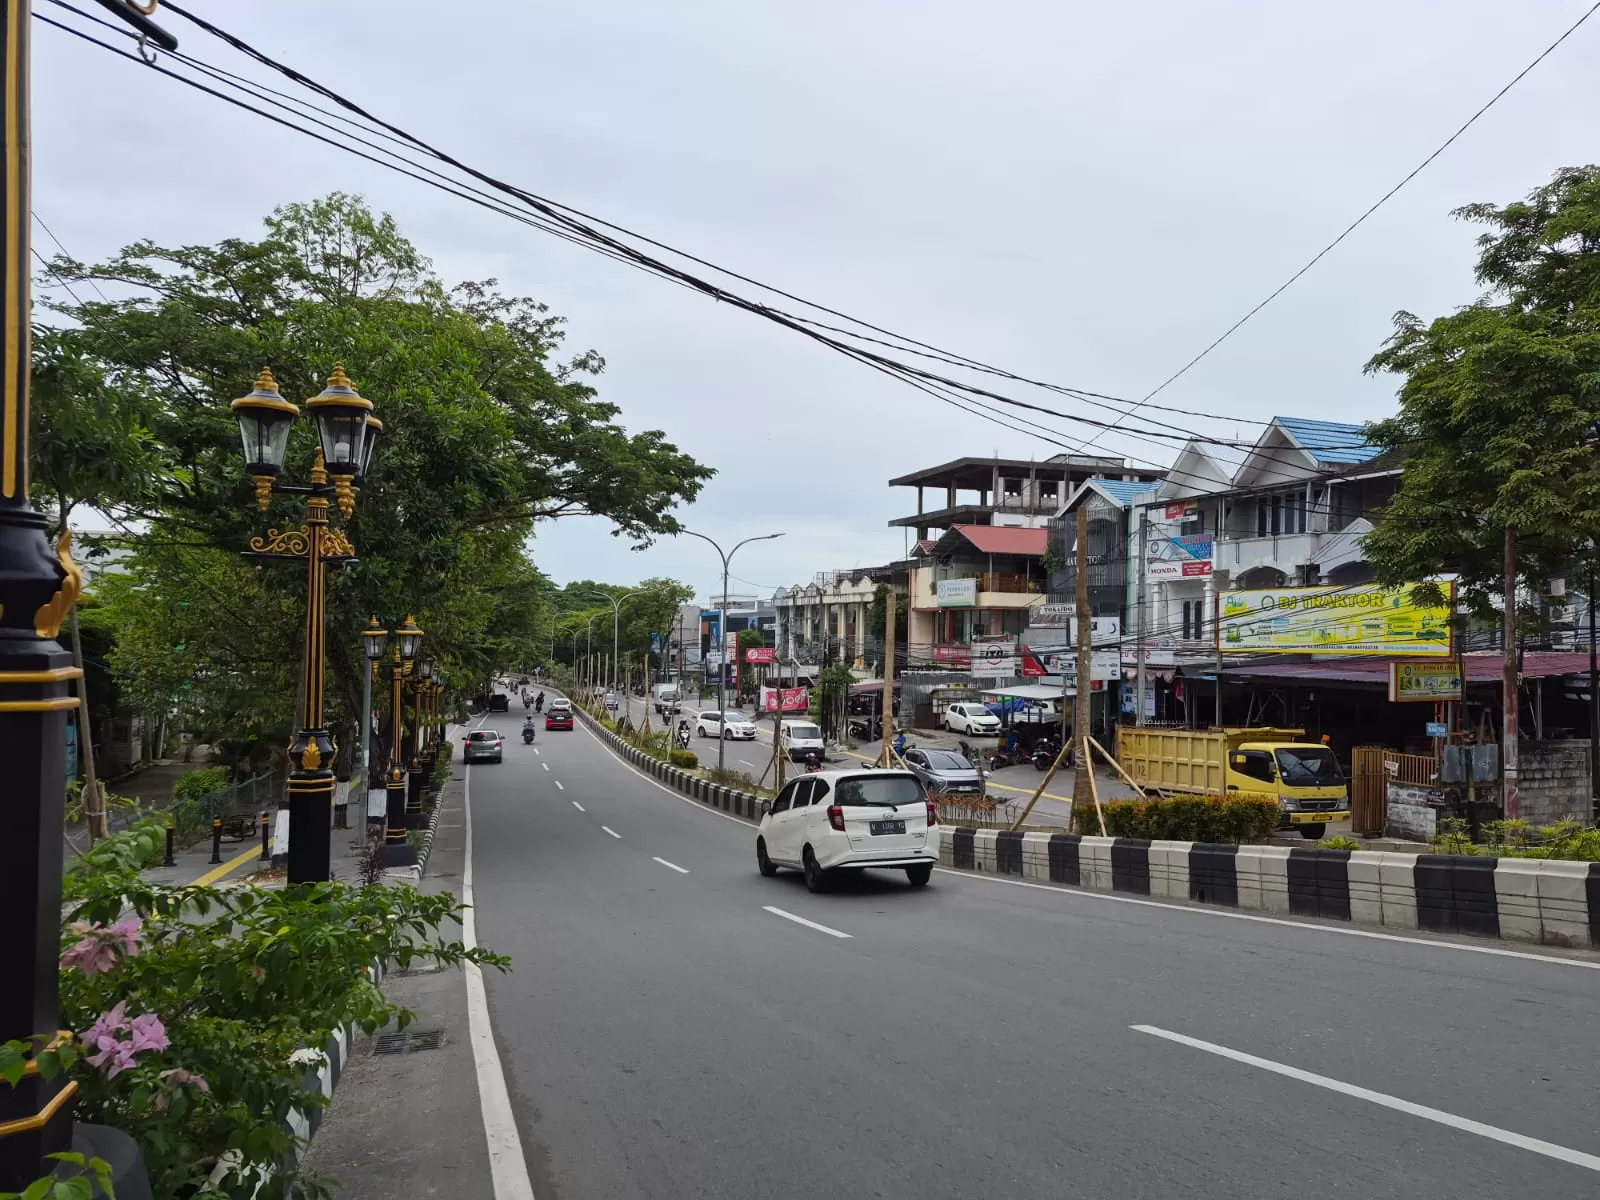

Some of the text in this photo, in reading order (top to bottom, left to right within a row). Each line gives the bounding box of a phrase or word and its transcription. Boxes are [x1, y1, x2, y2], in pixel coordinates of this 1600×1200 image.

[1150, 567, 1178, 575] HONDA
[1278, 593, 1384, 610] BJ TRAKTOR
